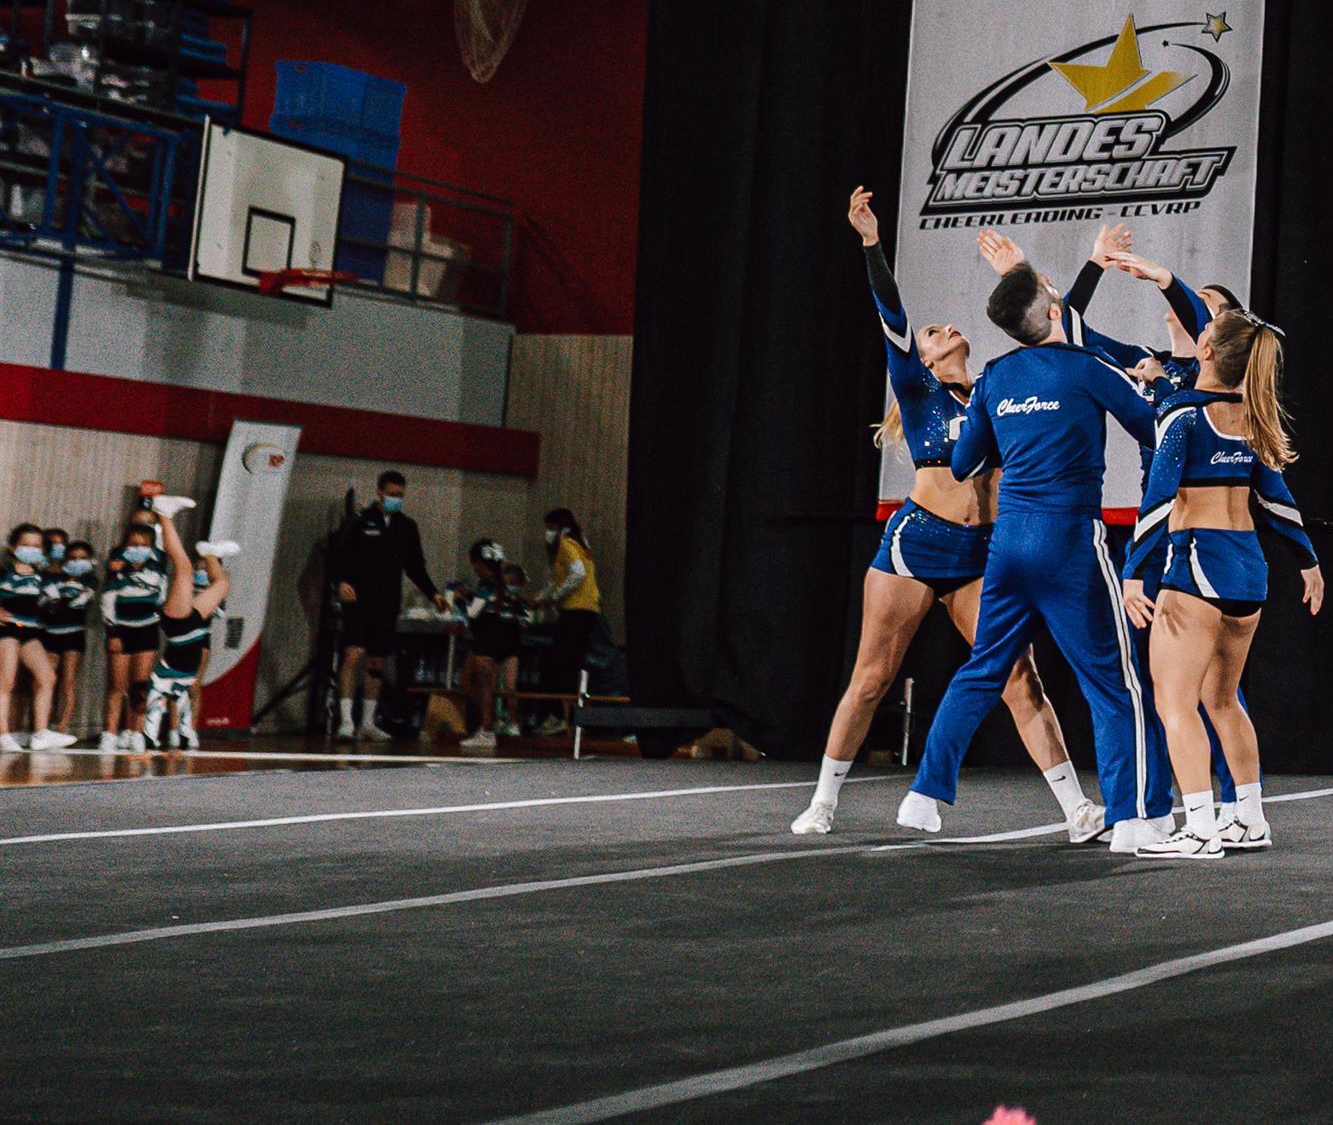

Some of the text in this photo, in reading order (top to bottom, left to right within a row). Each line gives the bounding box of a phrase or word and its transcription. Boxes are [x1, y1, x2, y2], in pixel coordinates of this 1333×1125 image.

[943, 117, 1162, 170] LANDES
[936, 155, 1221, 201] MEISTERSCHAFT
[919, 207, 1103, 230] CHEERLEADING
[1120, 201, 1201, 217] CCVRP
[997, 396, 1061, 416] CheerForce
